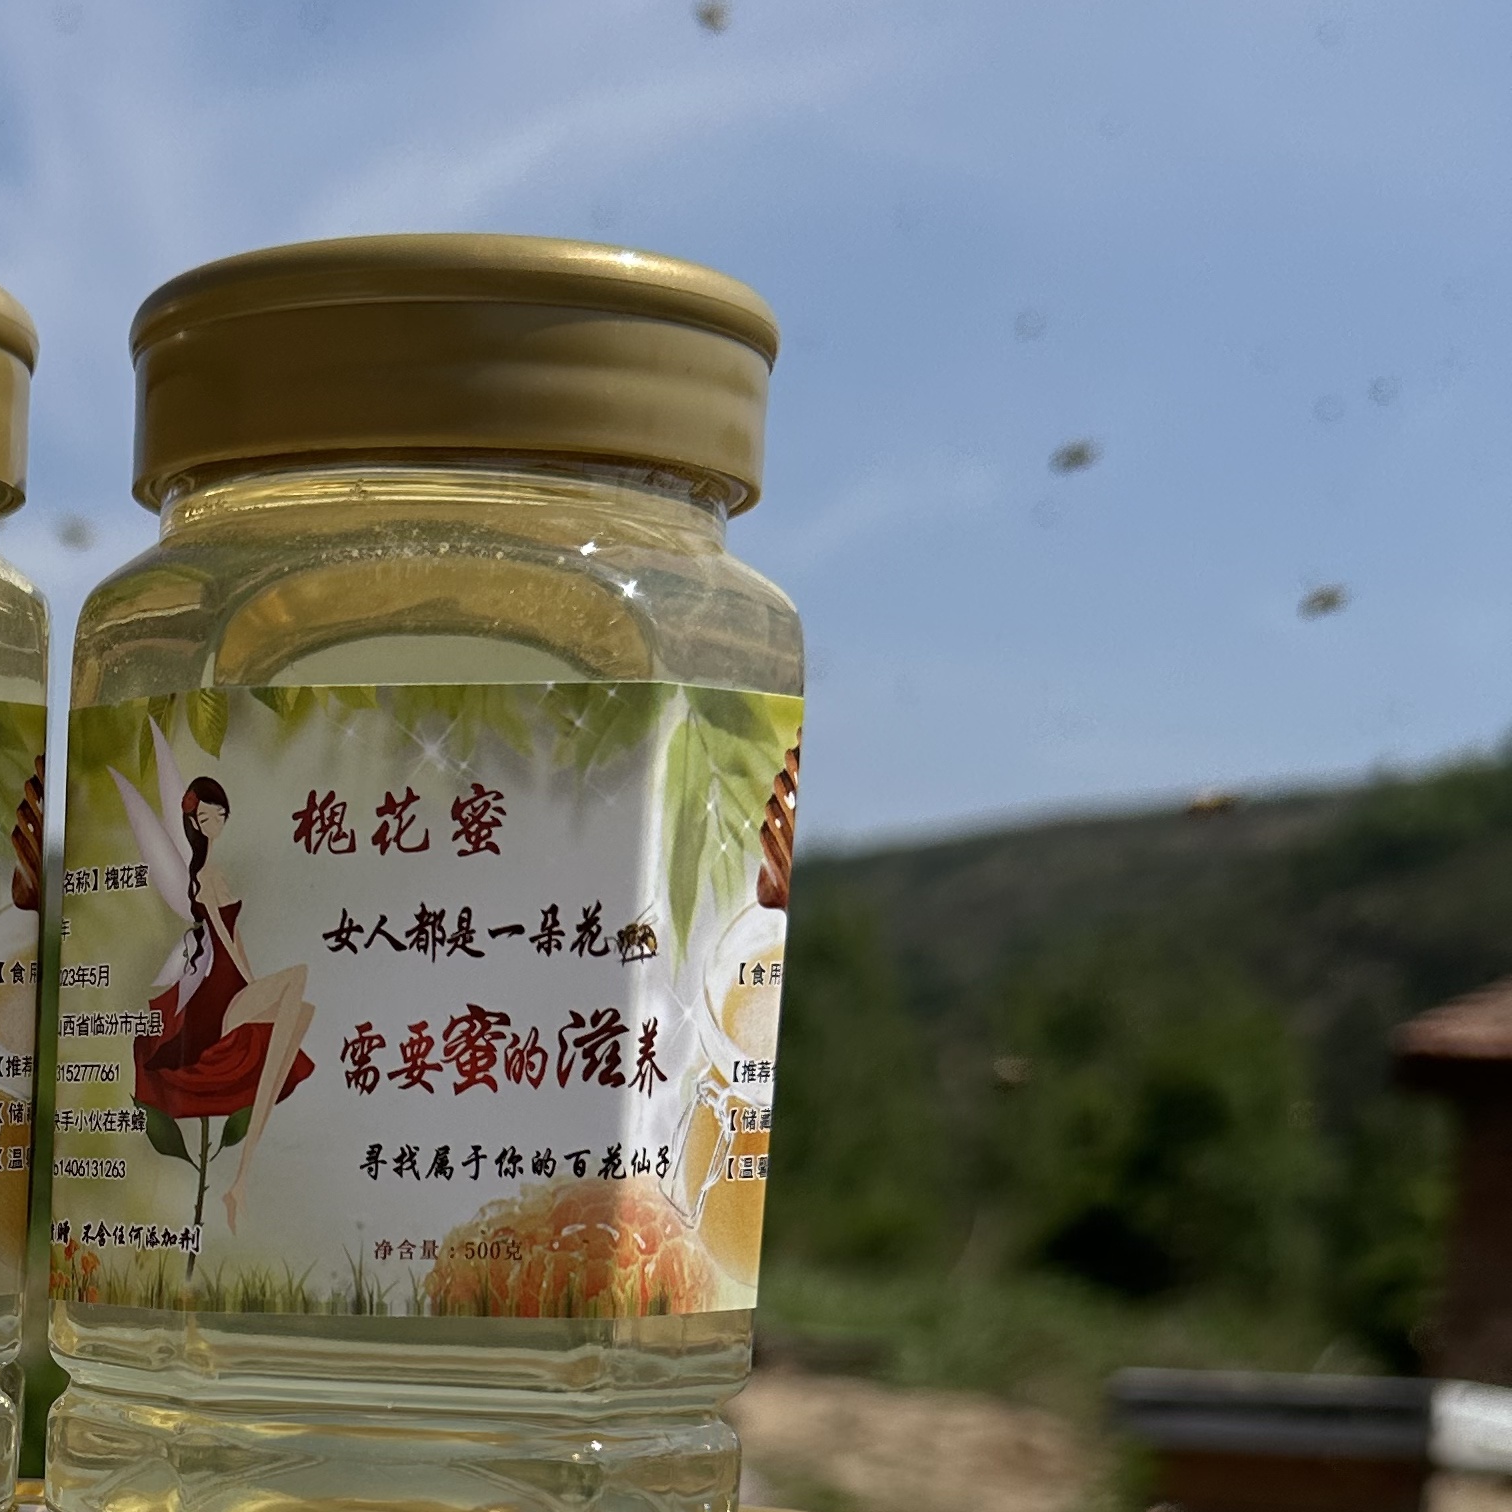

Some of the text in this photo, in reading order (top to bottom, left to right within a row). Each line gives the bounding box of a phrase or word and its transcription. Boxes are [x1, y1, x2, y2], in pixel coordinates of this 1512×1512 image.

[292, 783, 508, 857] 槐花蜜
[322, 902, 612, 963] 女人都是一朵花
[340, 1004, 669, 1098] 需要蜜的滋养
[359, 1144, 672, 1181] 寻找属于你的百花仙子
